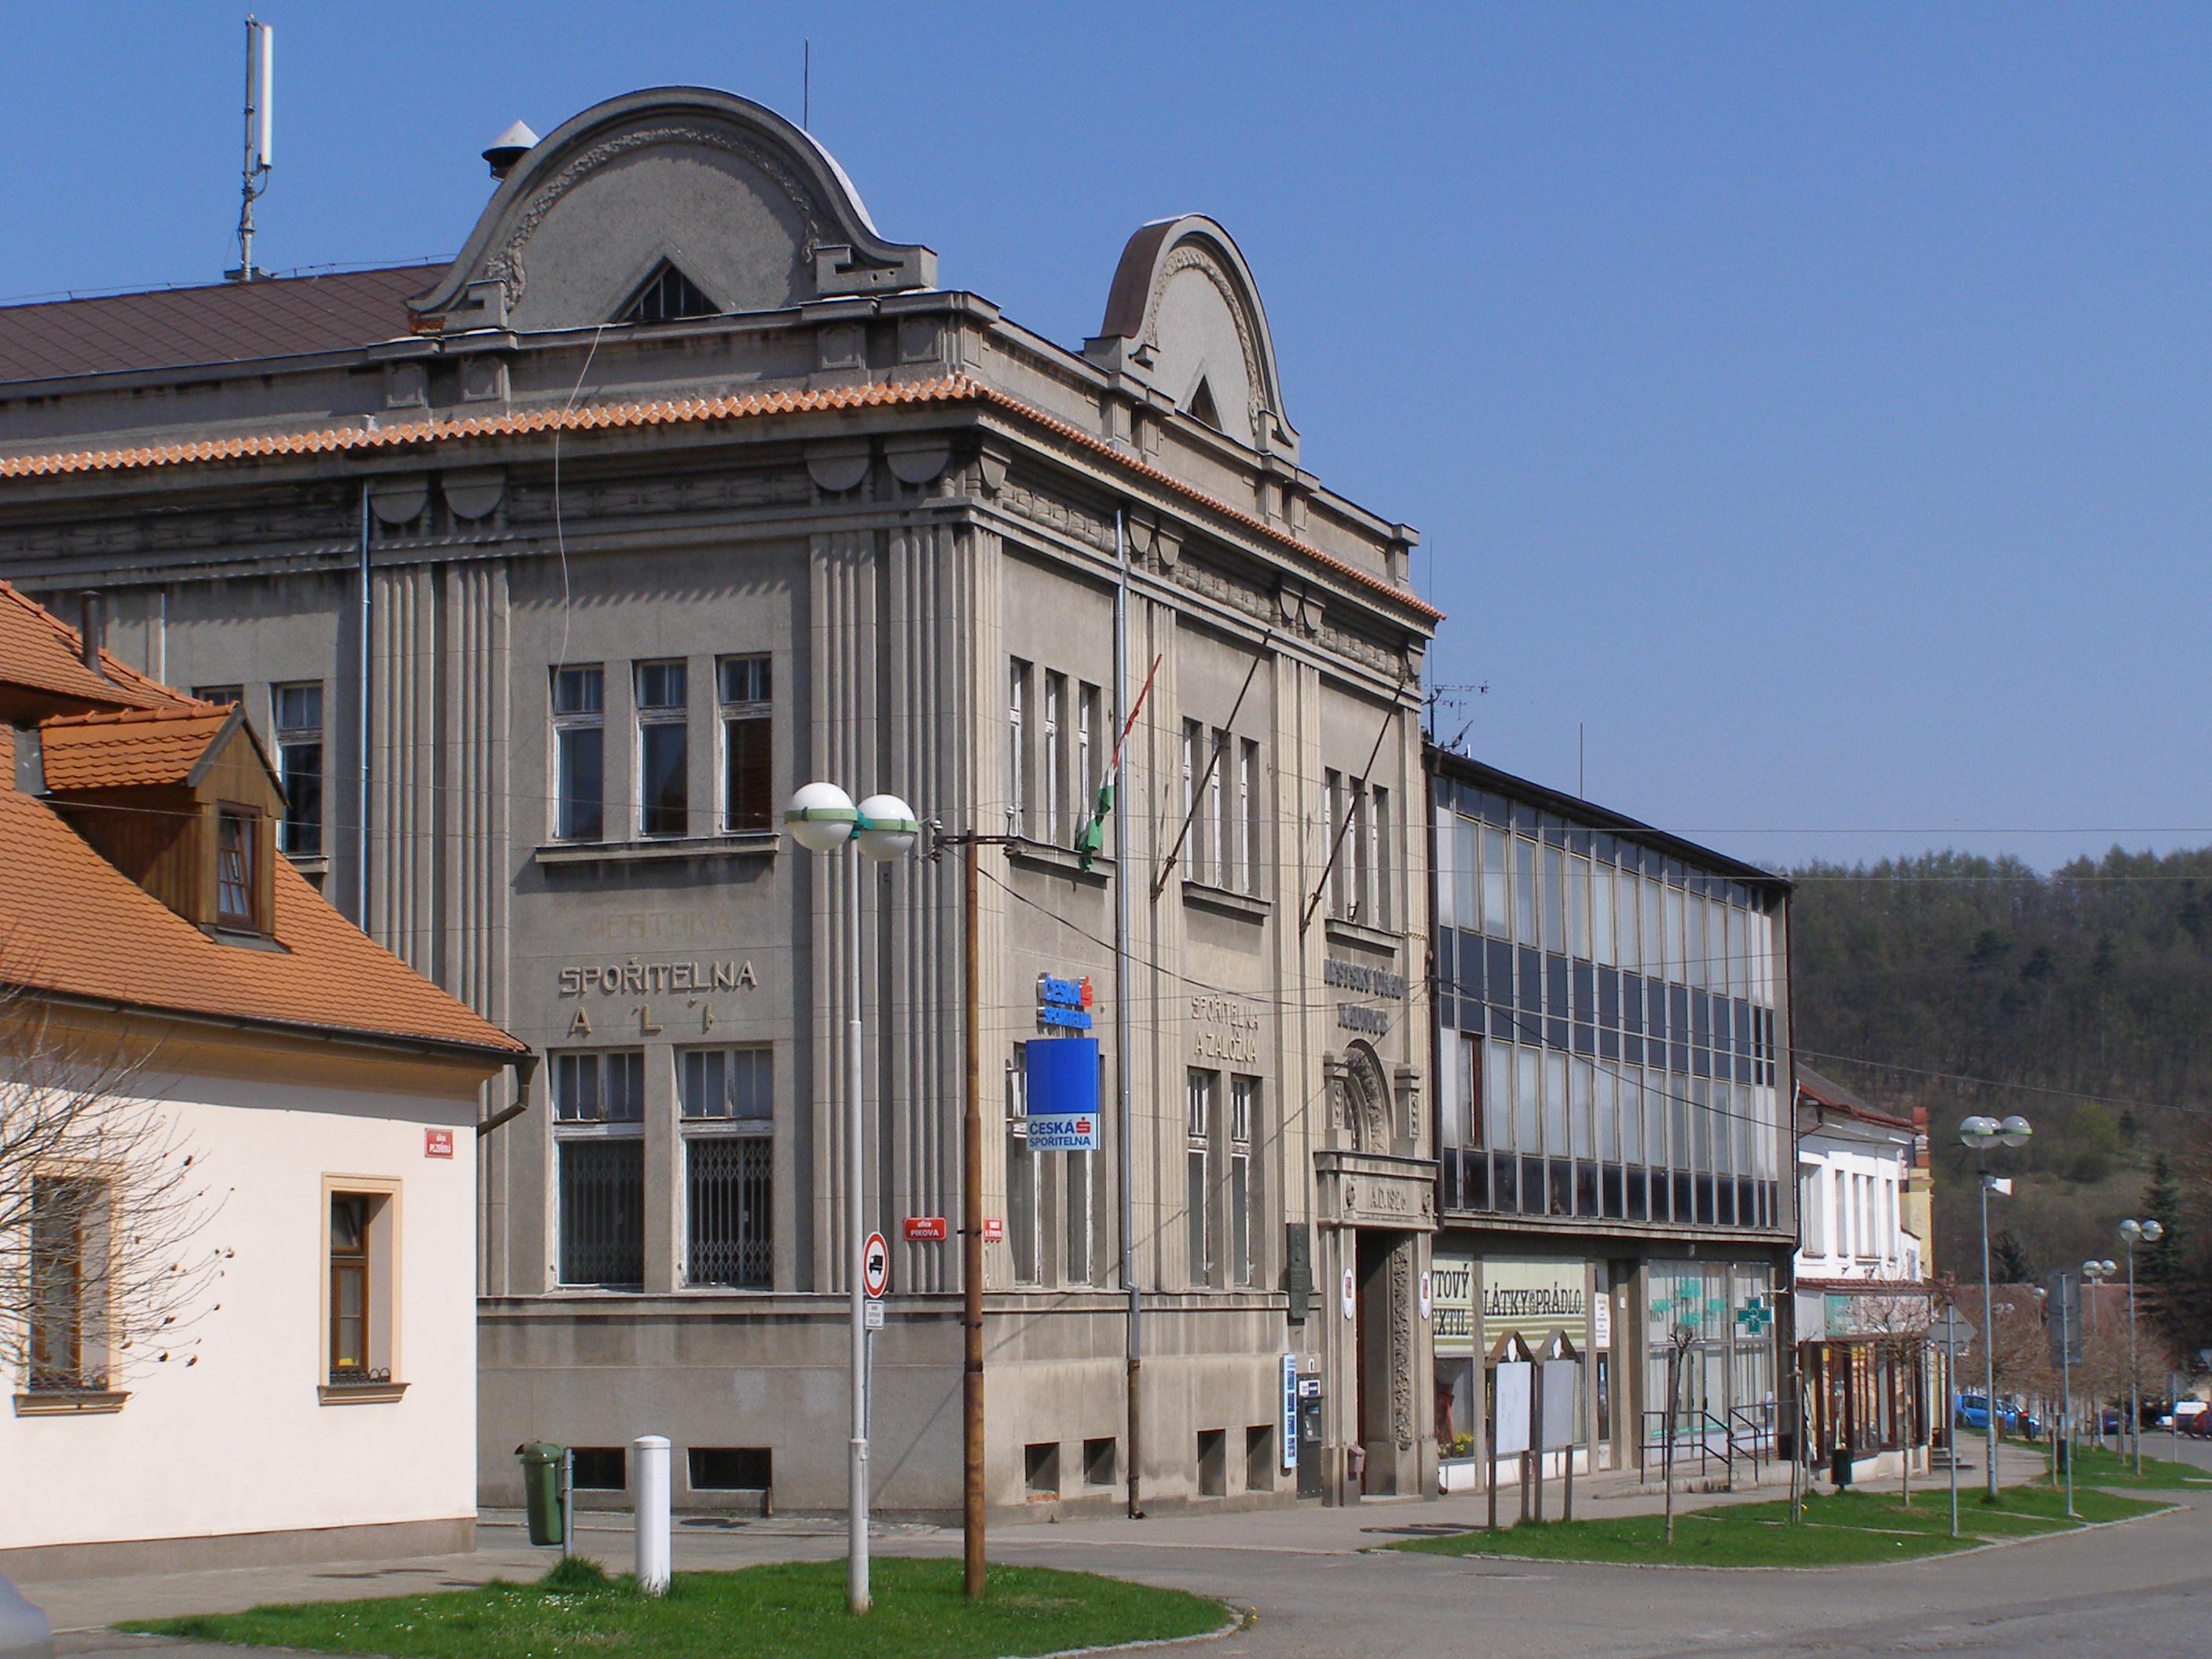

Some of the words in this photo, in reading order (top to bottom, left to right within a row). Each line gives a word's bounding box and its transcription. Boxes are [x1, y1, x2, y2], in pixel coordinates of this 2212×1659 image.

[559, 956, 758, 994] SPOŘITELNA
[1191, 994, 1258, 1030] SPOŘITELNA
[1030, 1119, 1075, 1135] ČESKÁ
[1030, 1135, 1091, 1148] SPOŘITELNA
[1484, 1282, 1529, 1316] LÁTKY
[1536, 1282, 1582, 1315] PRÁDLO
